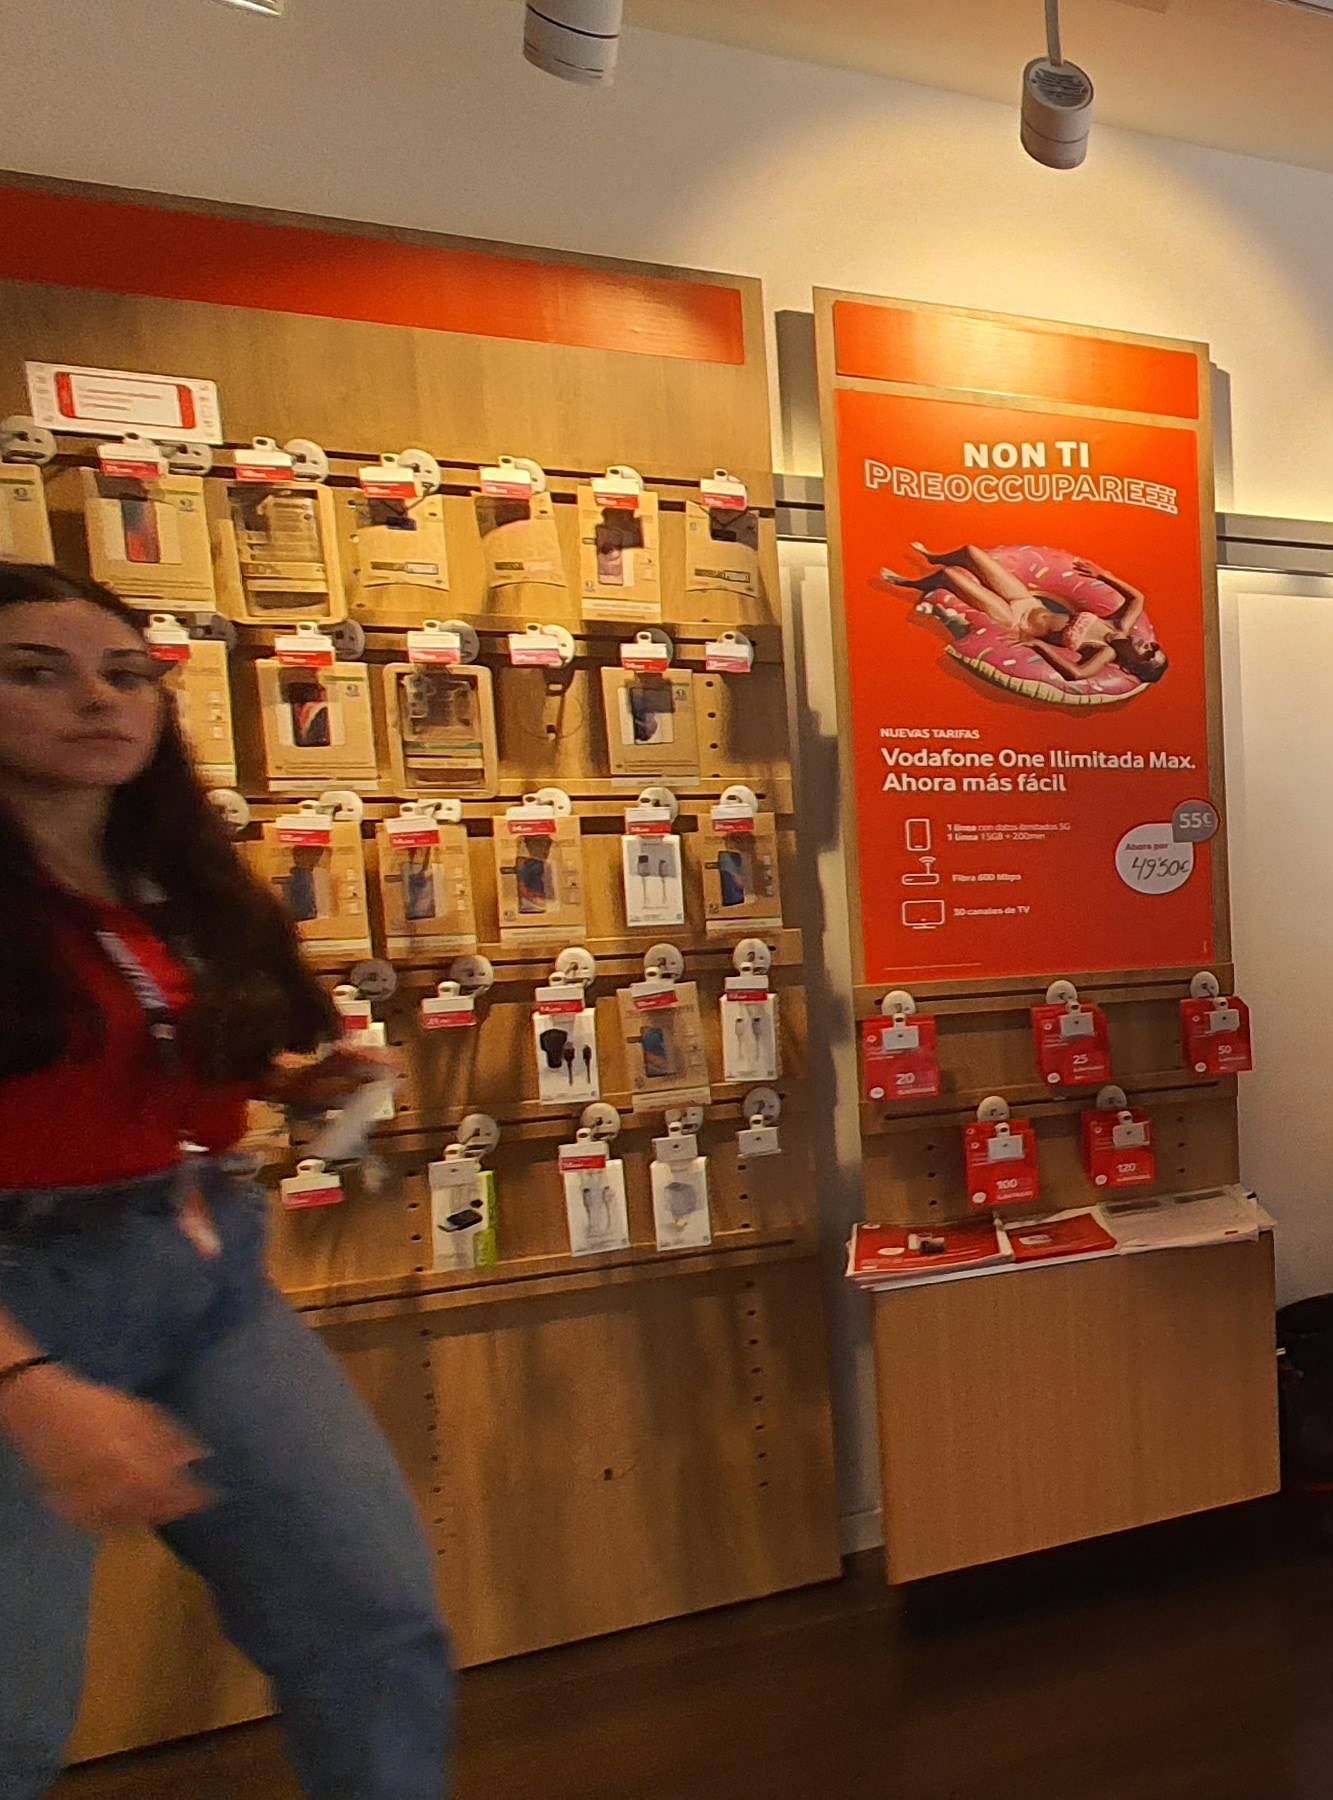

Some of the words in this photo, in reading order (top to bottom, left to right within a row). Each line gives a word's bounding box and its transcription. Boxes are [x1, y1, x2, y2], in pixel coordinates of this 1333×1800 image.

[963, 441, 1046, 468] NON
[1054, 441, 1089, 468] TI
[880, 728, 930, 739] NUEVAS
[932, 729, 980, 740] TARIFAS
[881, 748, 994, 768] Vodafone
[999, 749, 1045, 768] One
[1050, 750, 1145, 769] Ilimitada
[1149, 752, 1197, 771] Max.
[882, 774, 957, 792] Ahora
[962, 773, 1013, 792] más
[1017, 773, 1067, 792] fácil
[1179, 812, 1213, 829] 55€
[1072, 1053, 1089, 1065] 25
